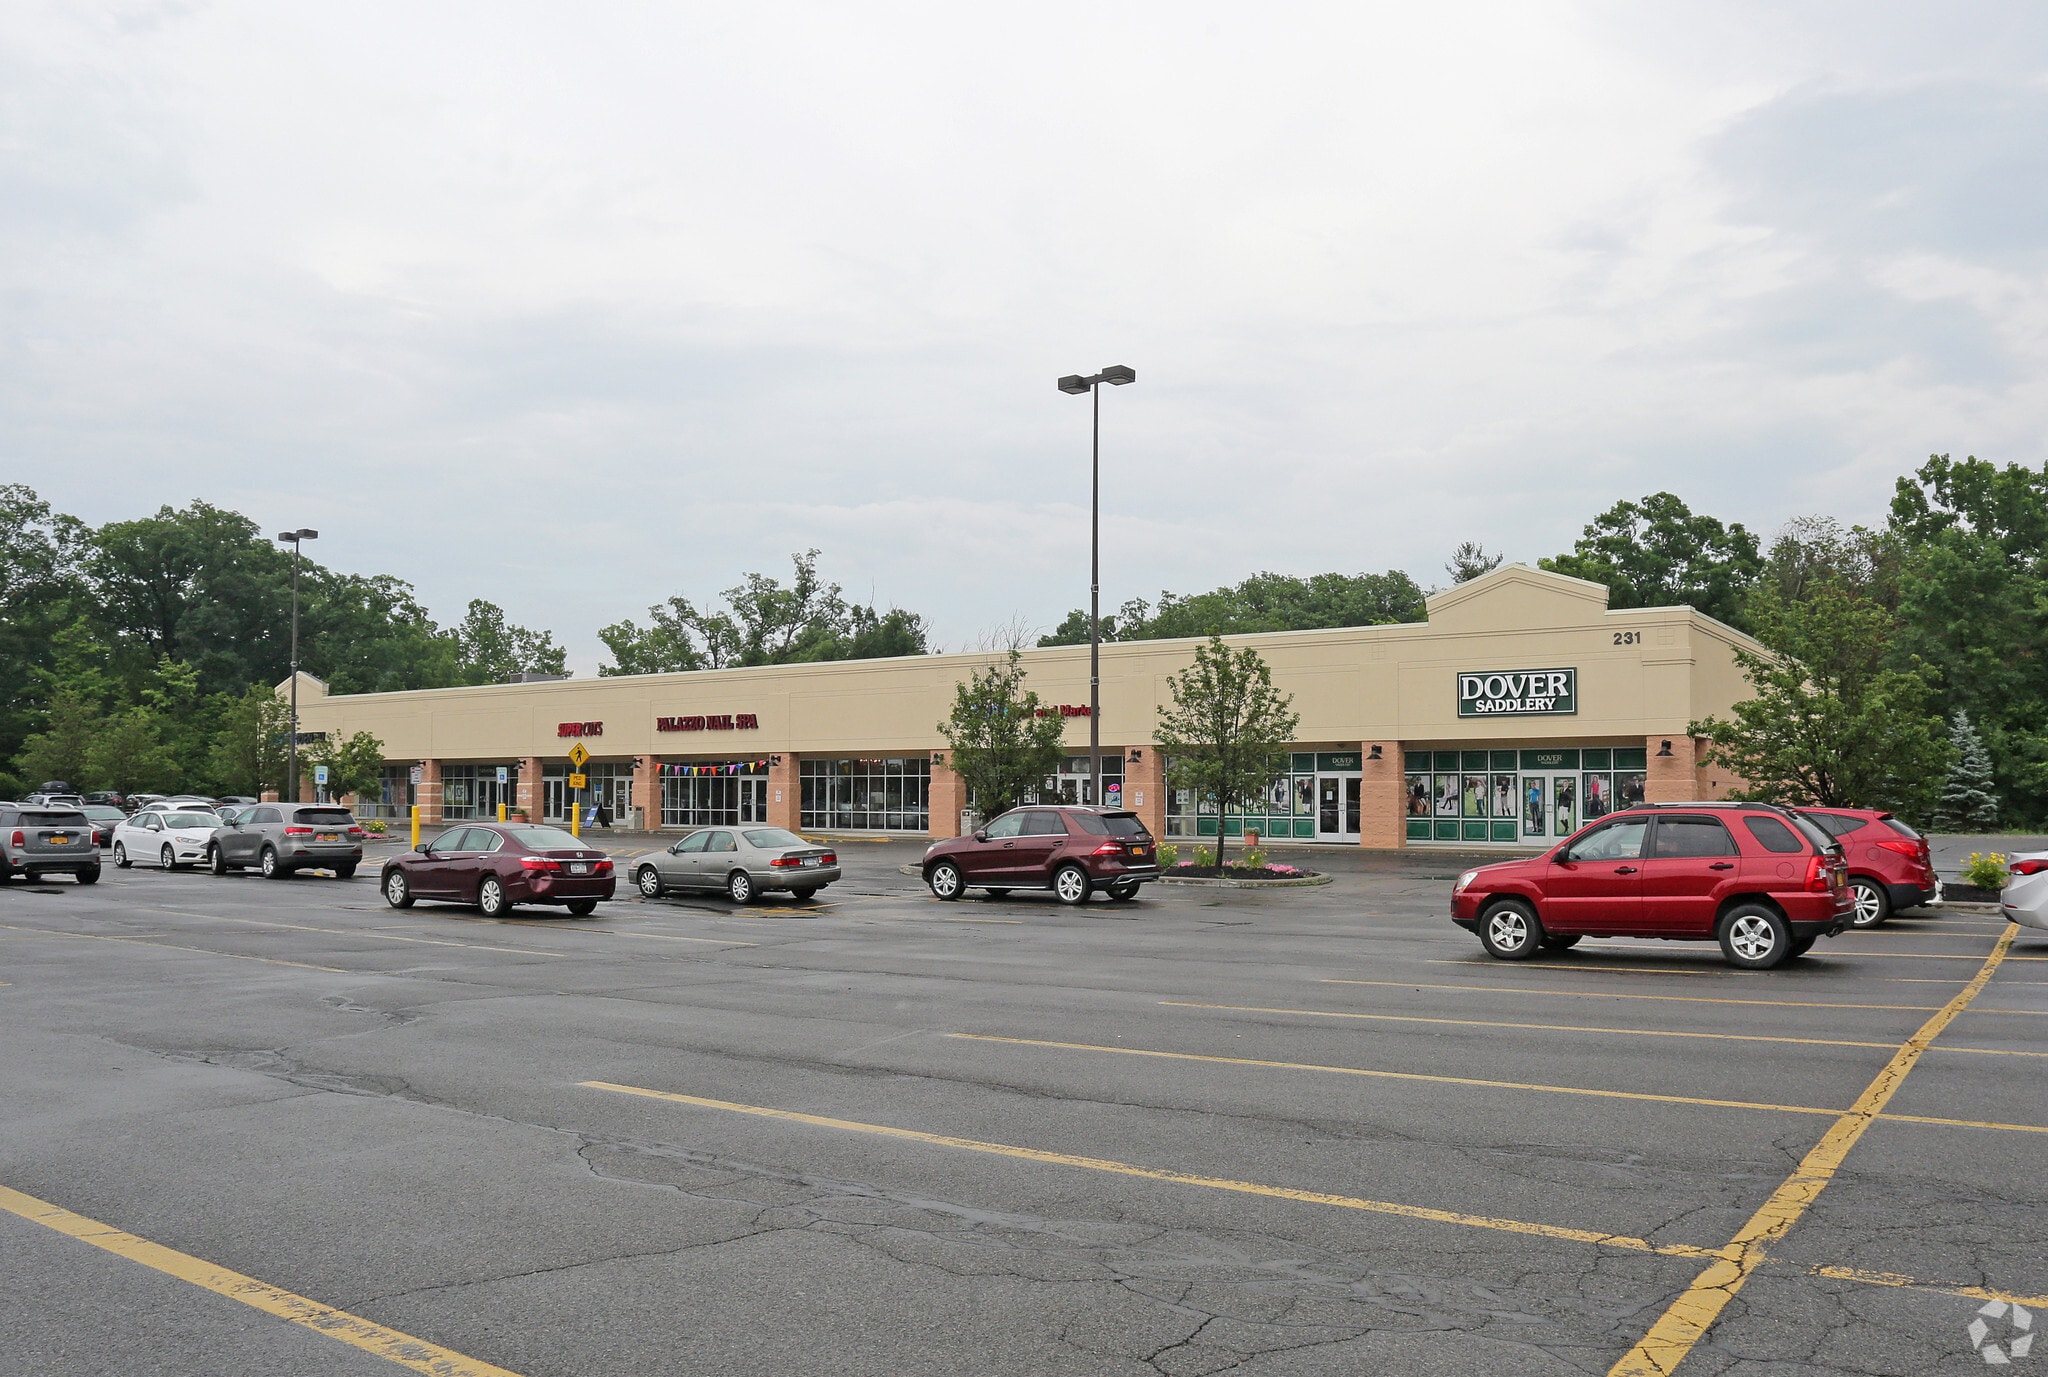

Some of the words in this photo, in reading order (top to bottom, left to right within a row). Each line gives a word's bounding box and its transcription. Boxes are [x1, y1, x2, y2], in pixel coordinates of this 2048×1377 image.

[1613, 631, 1641, 646] 231
[1461, 672, 1569, 700] DOVER
[1060, 704, 1100, 717] Marke
[1475, 697, 1557, 713] SADDLERY
[656, 716, 706, 732] PALAZZO
[705, 714, 735, 730] NAIL
[735, 713, 759, 729] SPA
